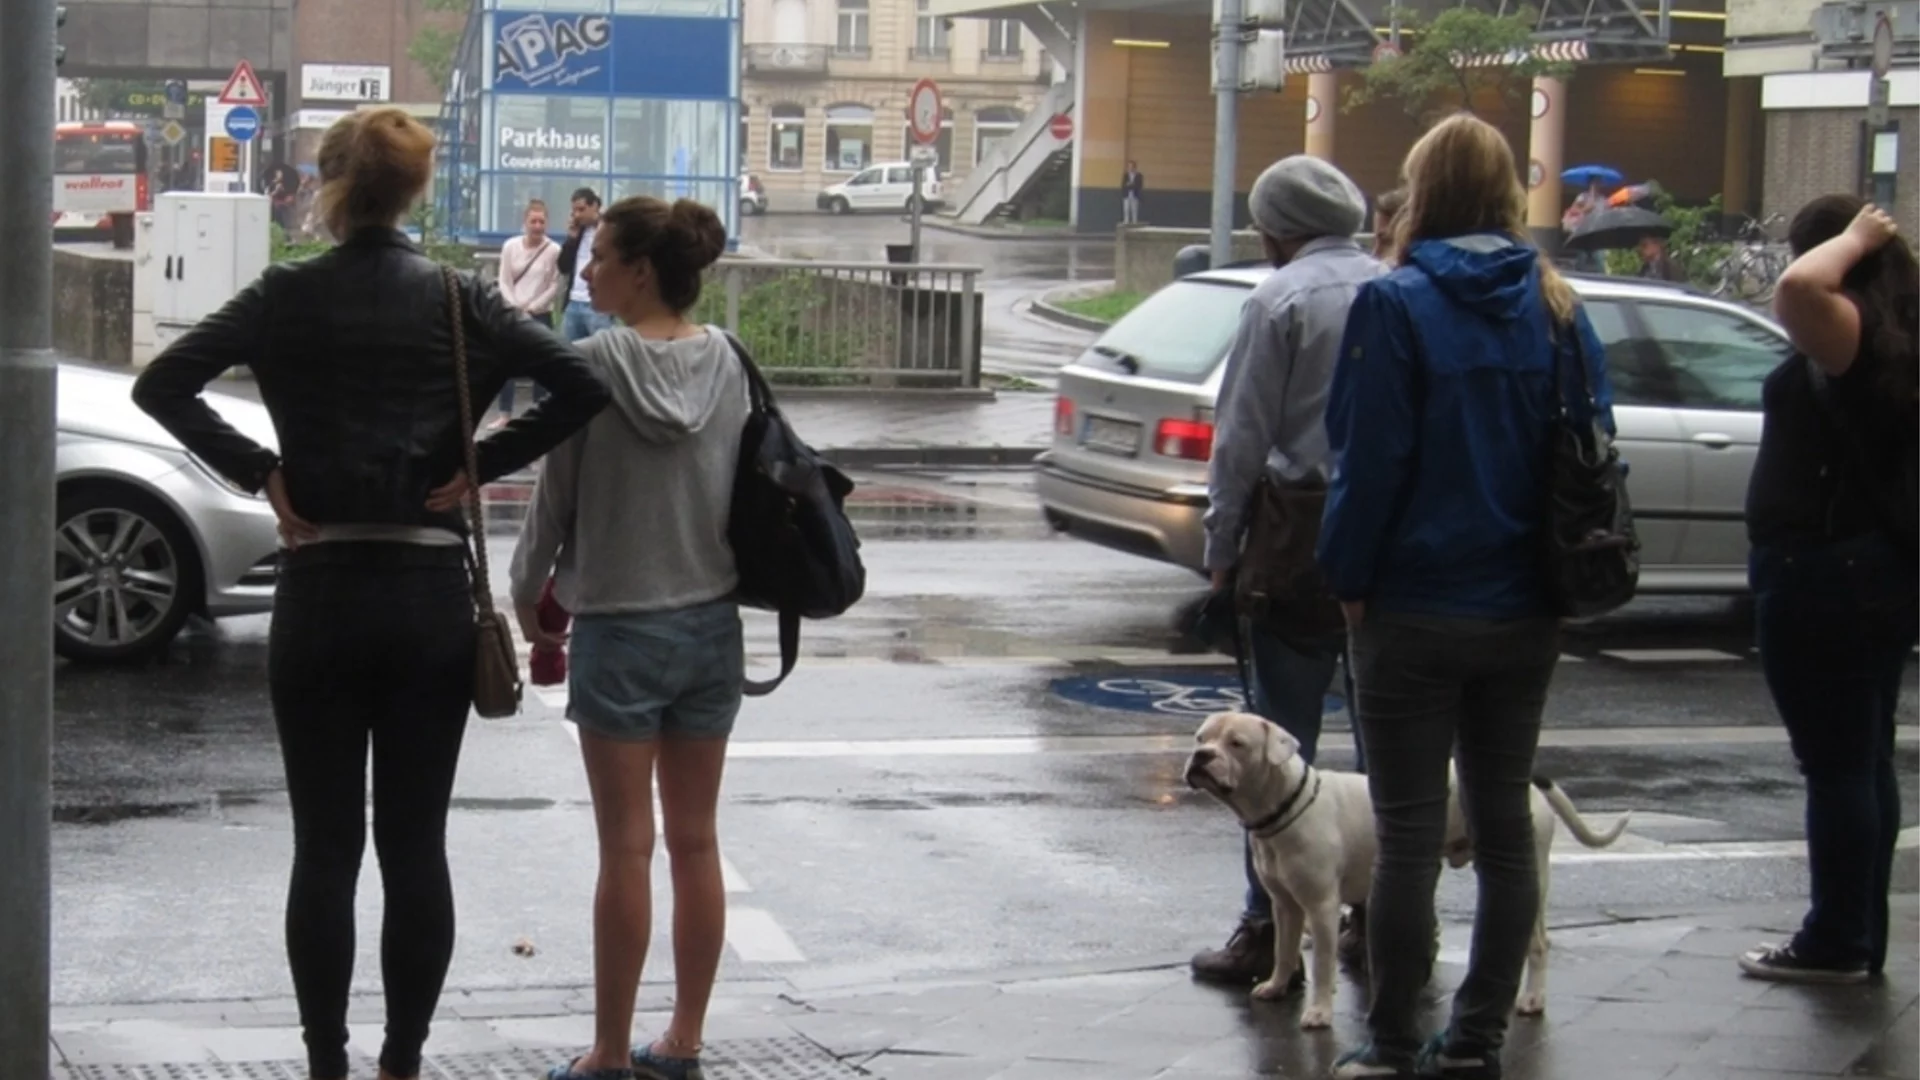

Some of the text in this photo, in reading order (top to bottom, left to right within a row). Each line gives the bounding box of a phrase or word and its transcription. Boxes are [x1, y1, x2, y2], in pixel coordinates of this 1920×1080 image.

[496, 13, 611, 80] APAG
[308, 76, 358, 97] Jünger
[500, 126, 601, 150] Parkhaus
[500, 151, 601, 171] Couvenstraße
